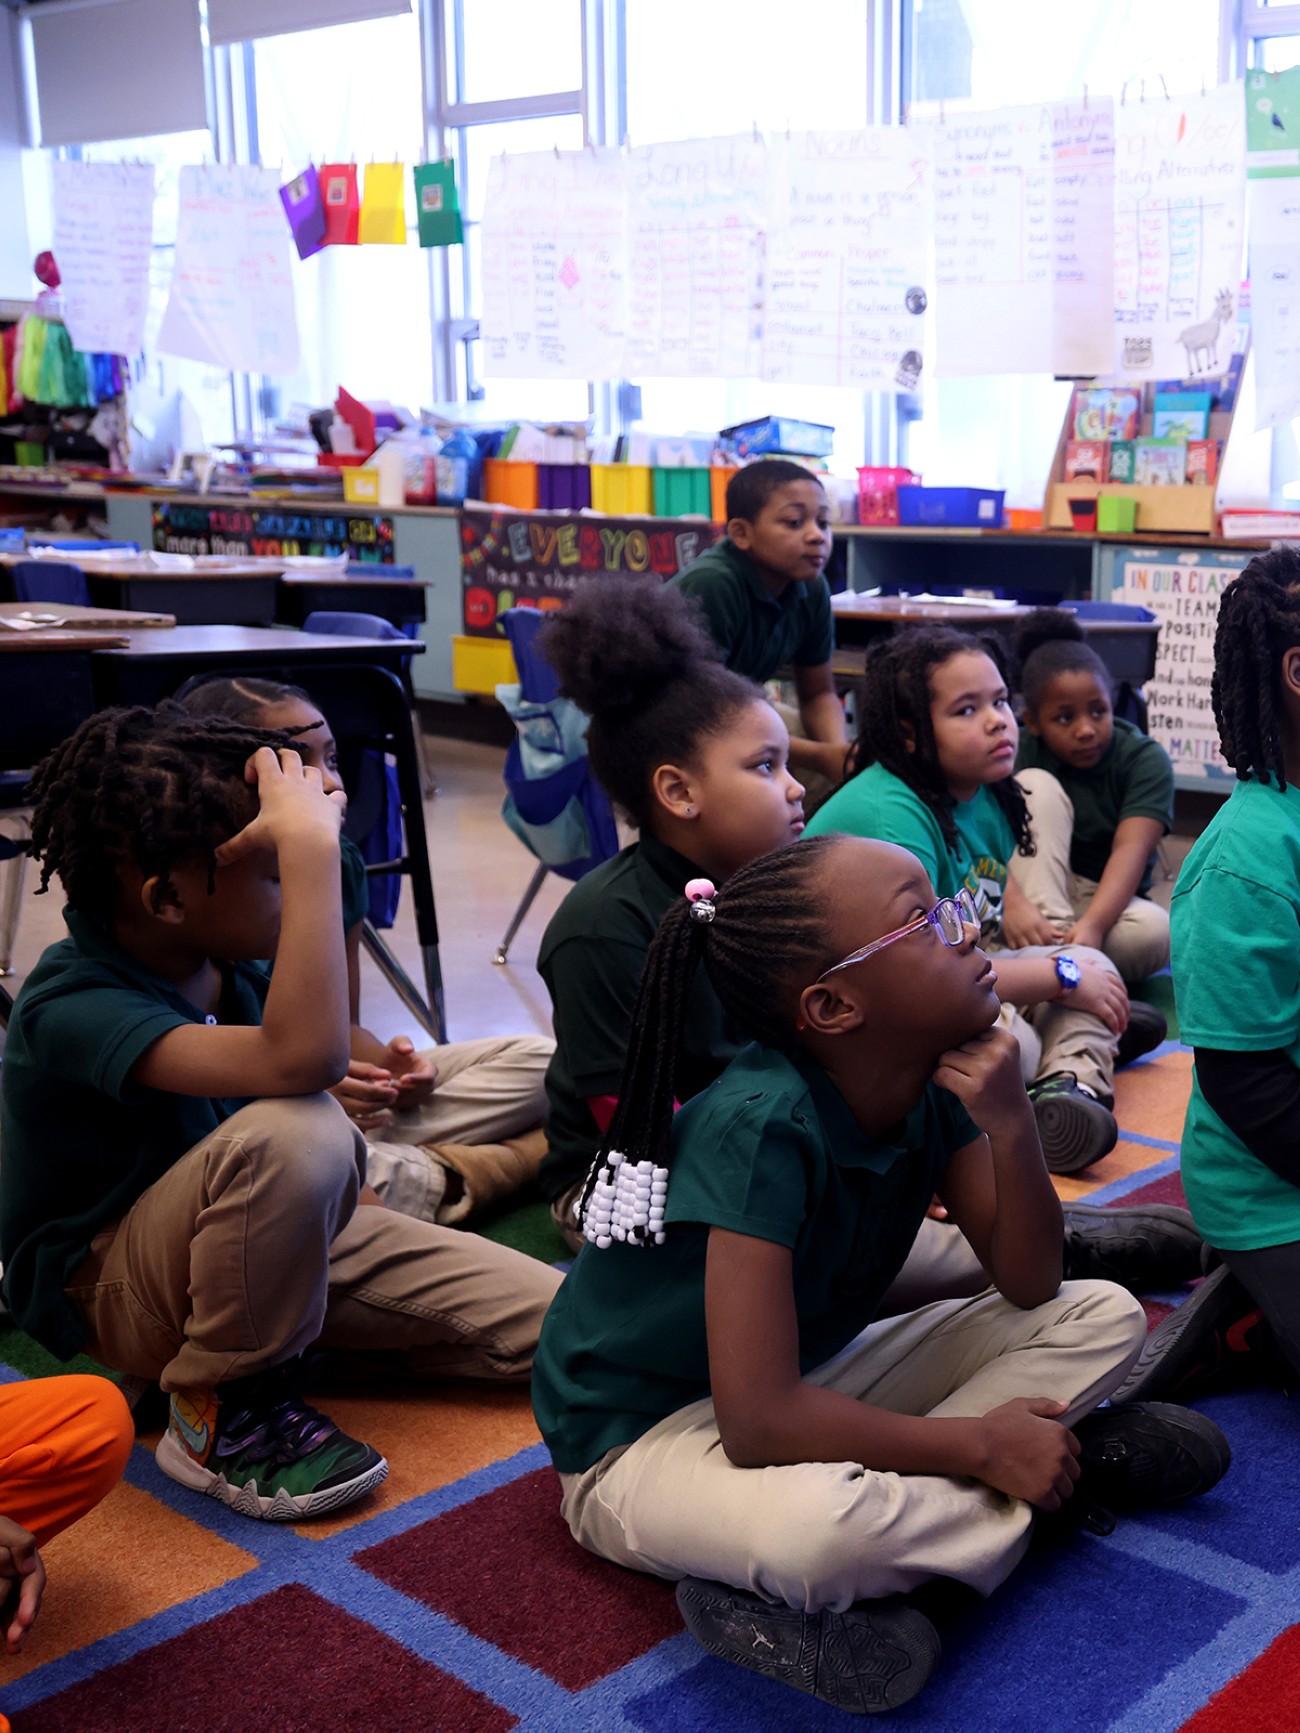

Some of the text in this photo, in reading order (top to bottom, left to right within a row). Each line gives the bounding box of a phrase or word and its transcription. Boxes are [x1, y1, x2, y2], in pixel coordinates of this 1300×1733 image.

[806, 131, 881, 155] Nouns
[507, 521, 700, 574] EVERYONE
[1131, 569, 1147, 591] IN
[1153, 570, 1183, 593] OUR
[1176, 597, 1217, 617] TEAM
[1170, 737, 1222, 762] MATTE
